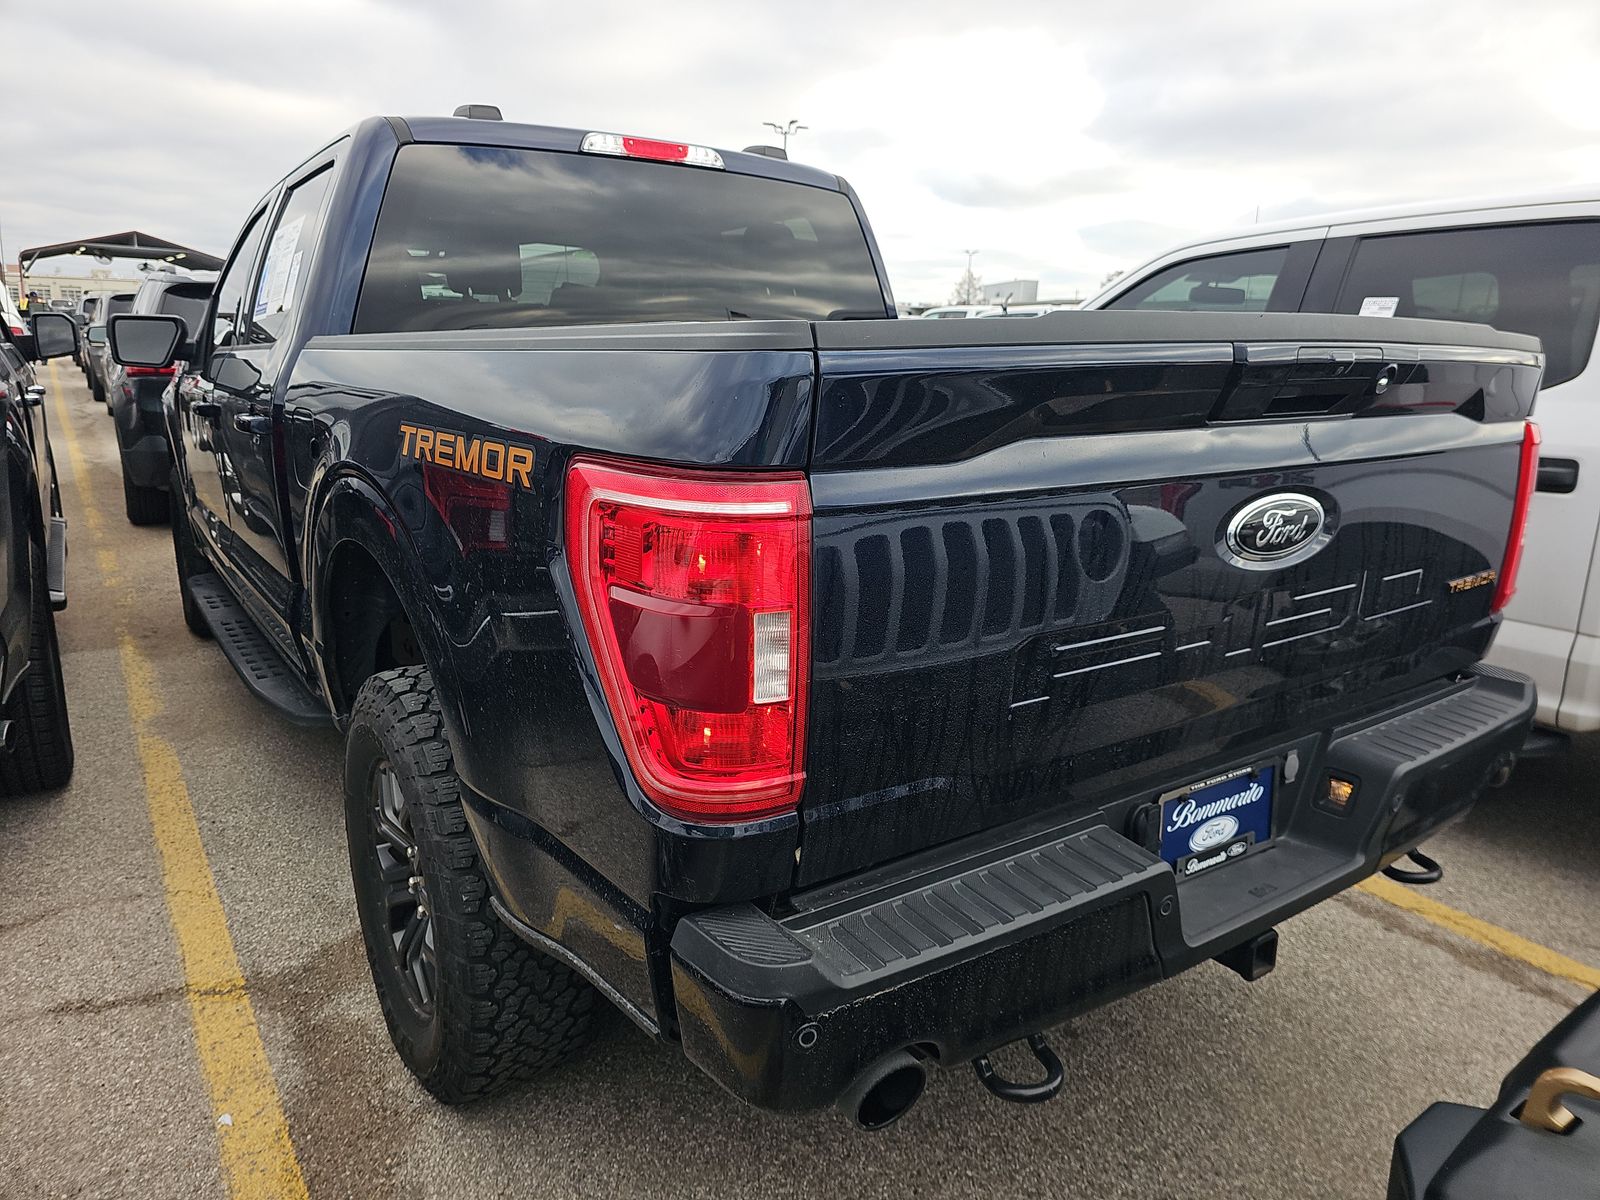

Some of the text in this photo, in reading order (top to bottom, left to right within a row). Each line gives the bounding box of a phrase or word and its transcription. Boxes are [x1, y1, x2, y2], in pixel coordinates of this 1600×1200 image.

[400, 423, 534, 489] TREMOR
[1256, 508, 1309, 548] Ford
[1448, 570, 1496, 593] TREMOR
[1190, 766, 1253, 791] THE FORD STORE
[1166, 782, 1264, 833] Bommarito
[1201, 822, 1227, 842] Ford
